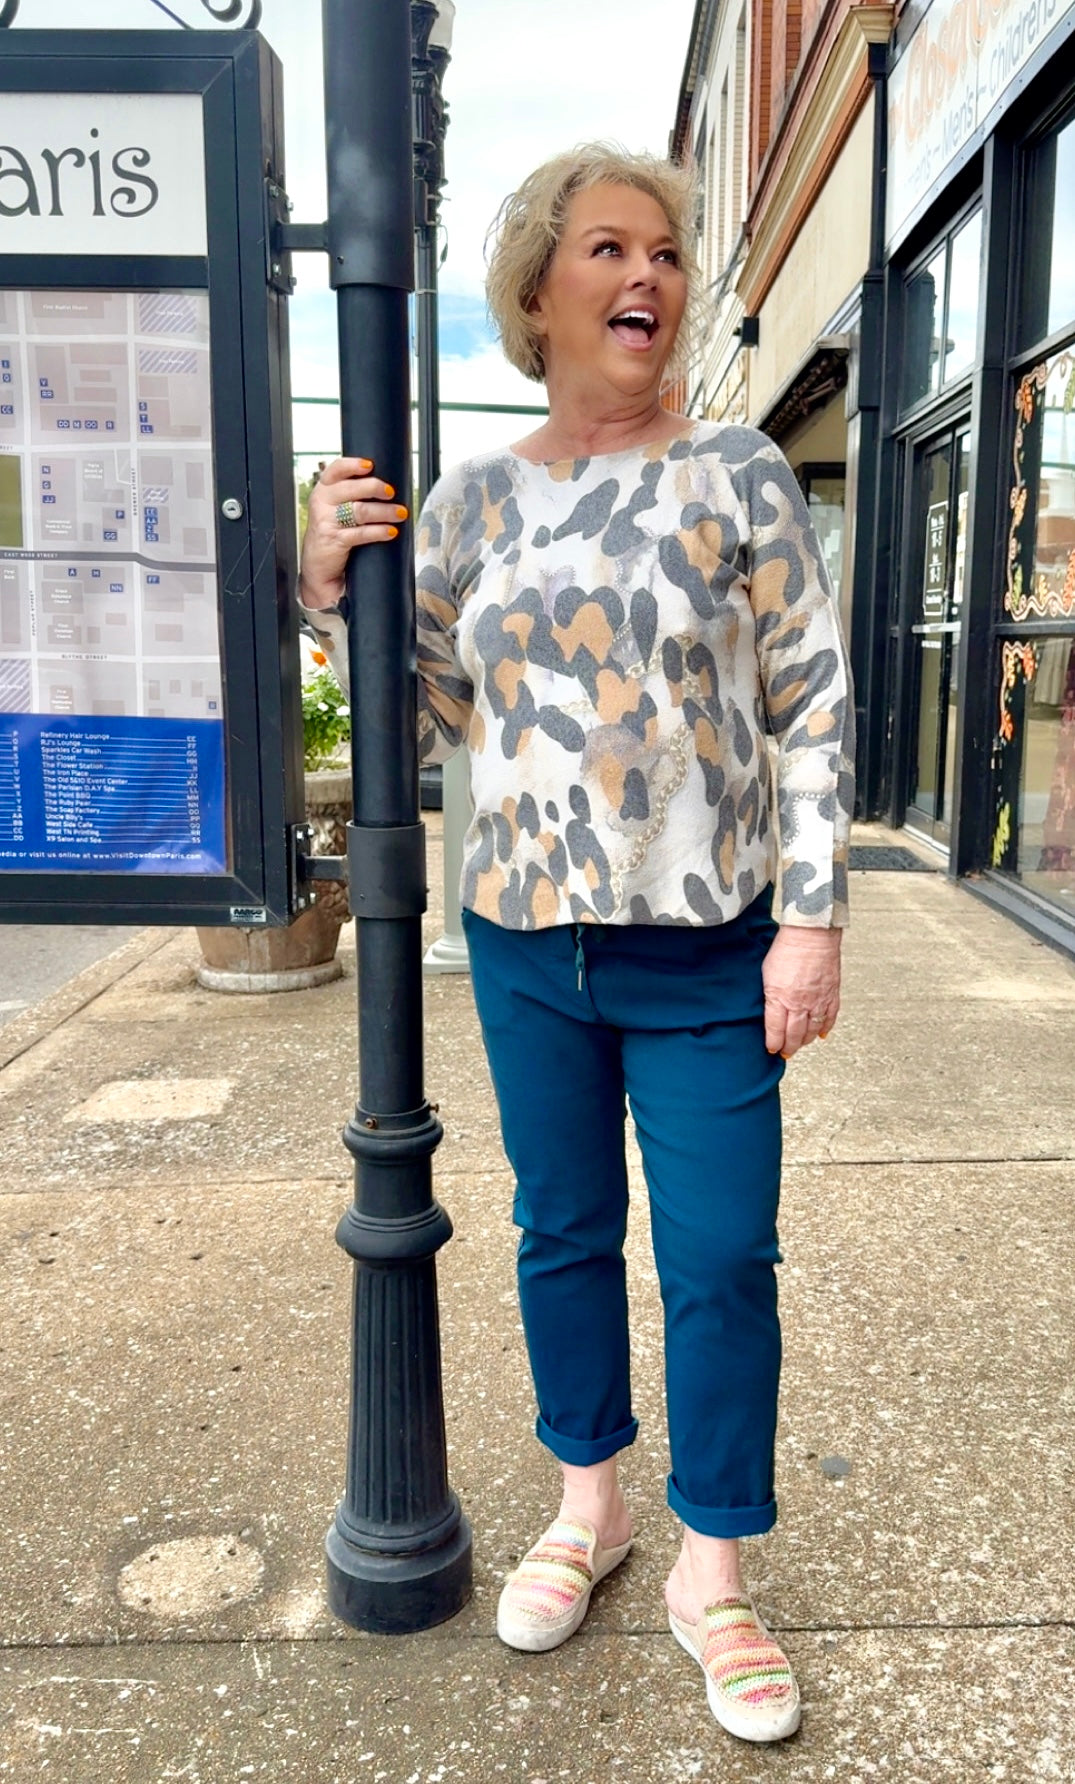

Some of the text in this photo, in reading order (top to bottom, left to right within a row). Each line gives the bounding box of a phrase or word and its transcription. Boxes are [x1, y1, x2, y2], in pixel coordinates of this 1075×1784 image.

[40, 731, 68, 739] Refinery
[41, 746, 70, 754] Sparkles
[75, 807, 100, 815] Factory
[73, 829, 100, 837] Printing
[93, 852, 202, 860] www.VisitDowntownParis.com
